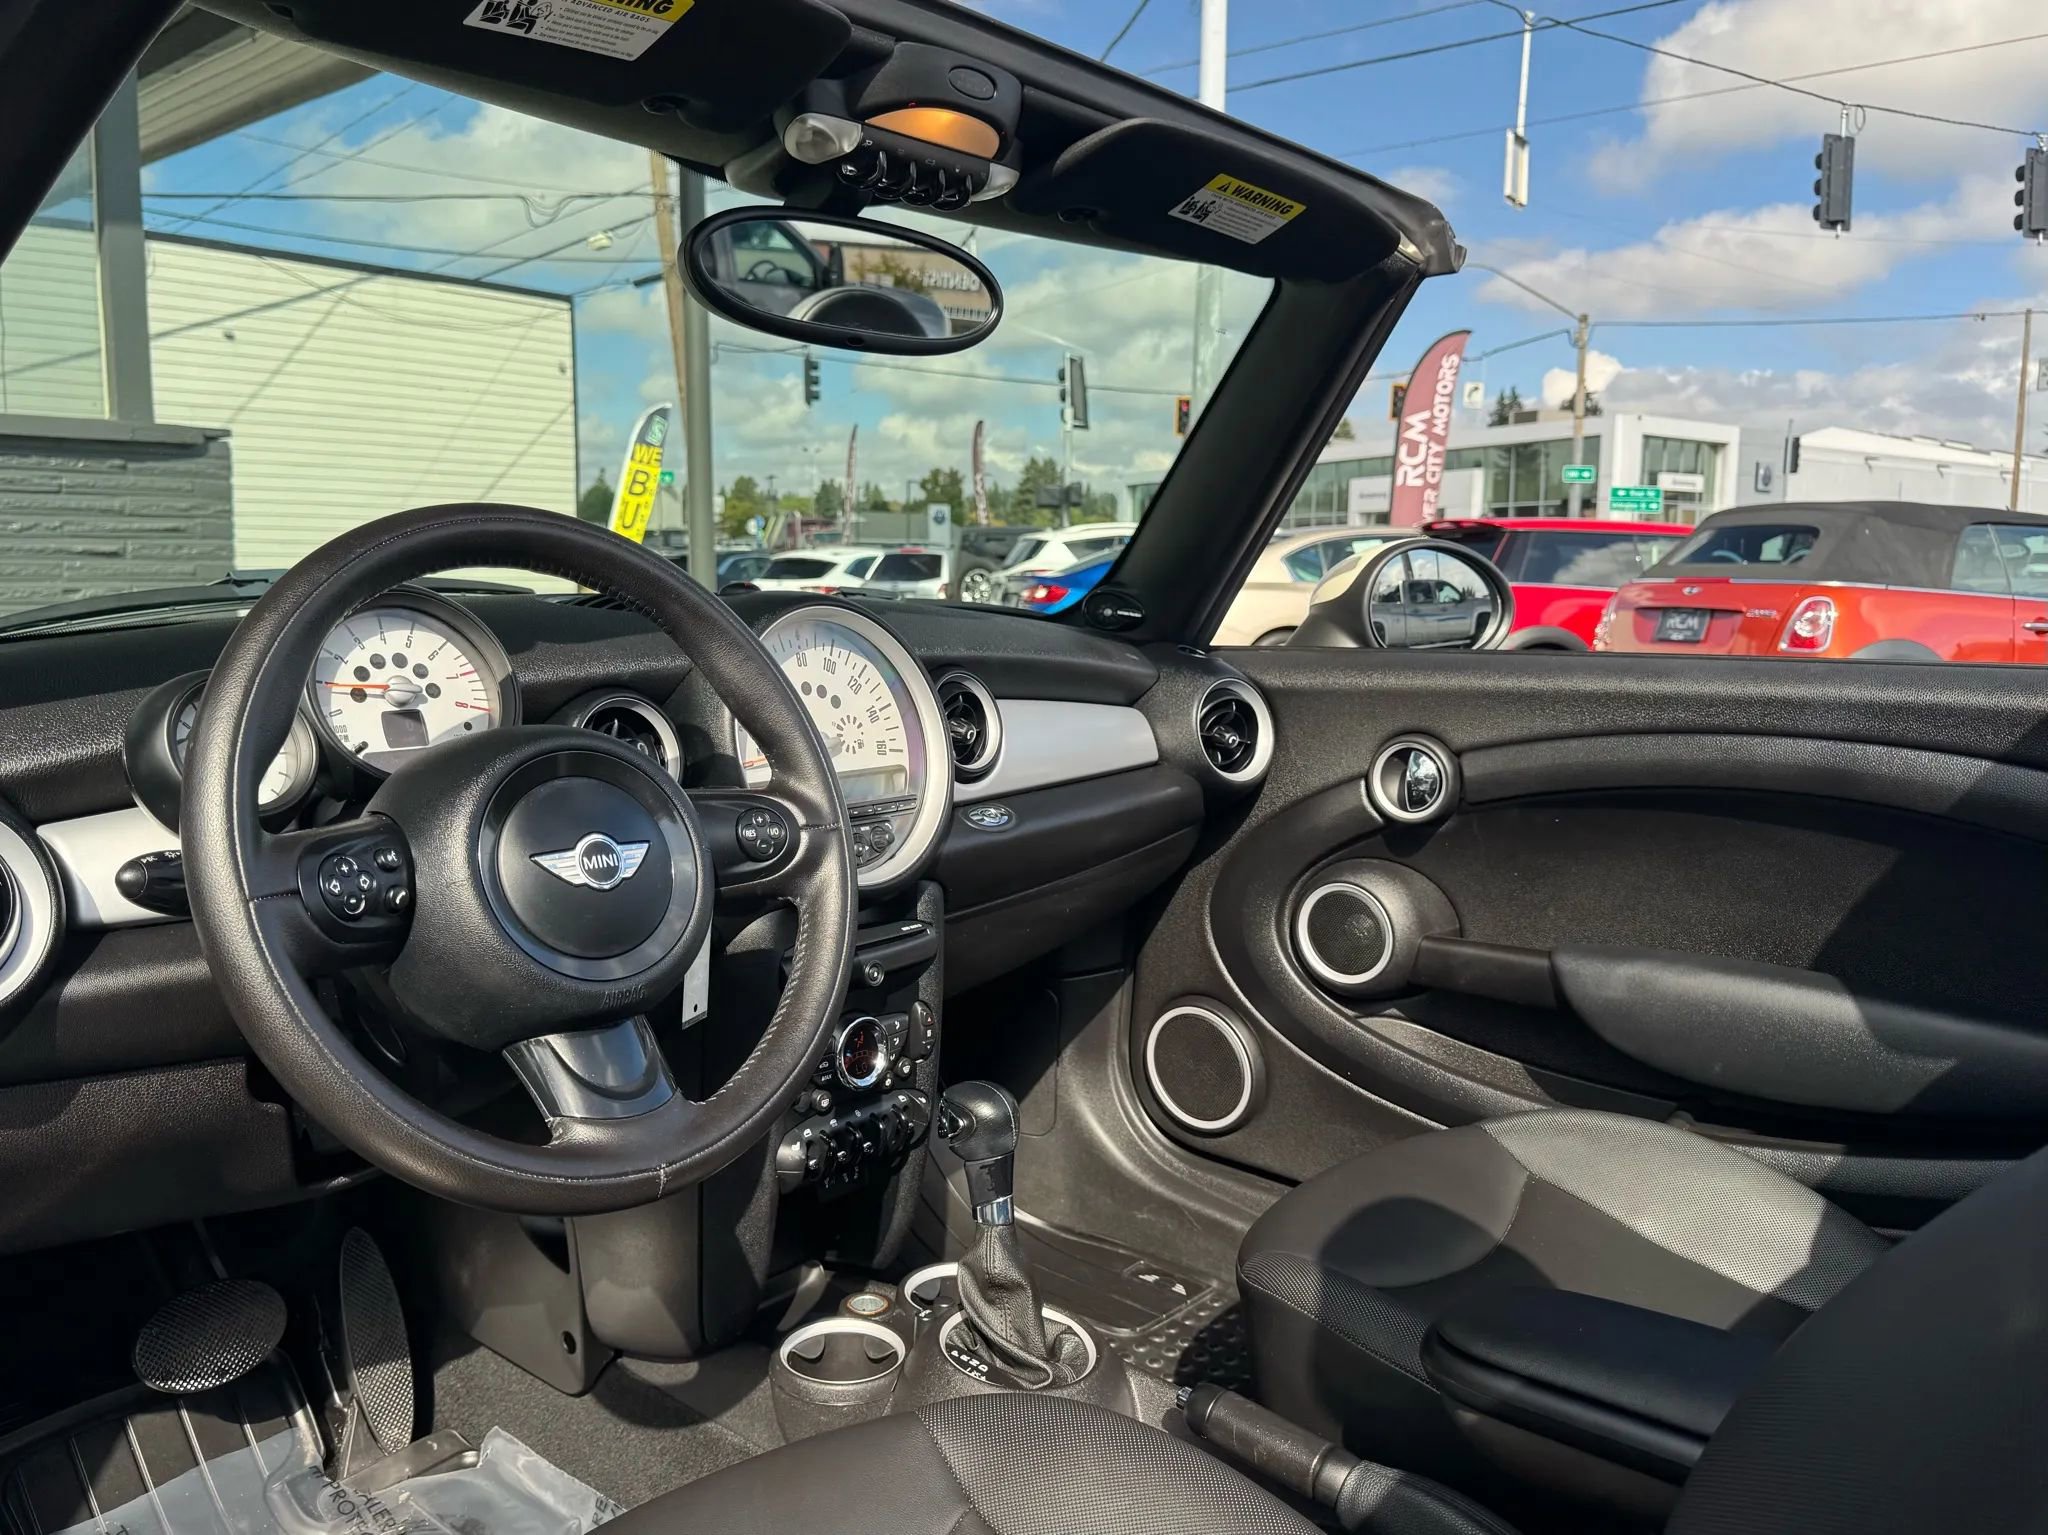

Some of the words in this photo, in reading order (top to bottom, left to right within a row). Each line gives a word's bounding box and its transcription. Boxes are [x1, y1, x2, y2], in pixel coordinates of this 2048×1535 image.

[630, 13, 650, 23] BAGS
[1232, 184, 1294, 215] WARNING
[1431, 353, 1461, 437] MOTORS
[632, 443, 663, 466] WE
[1396, 410, 1432, 487] RCM
[1425, 440, 1446, 484] CITY
[796, 652, 808, 668] 80
[822, 657, 837, 675] 100
[847, 675, 863, 695] 120
[866, 704, 880, 724] 140
[875, 739, 888, 756] 160
[745, 829, 757, 837] RES
[582, 853, 619, 870] MINI
[602, 985, 646, 1008] AIRBAG
